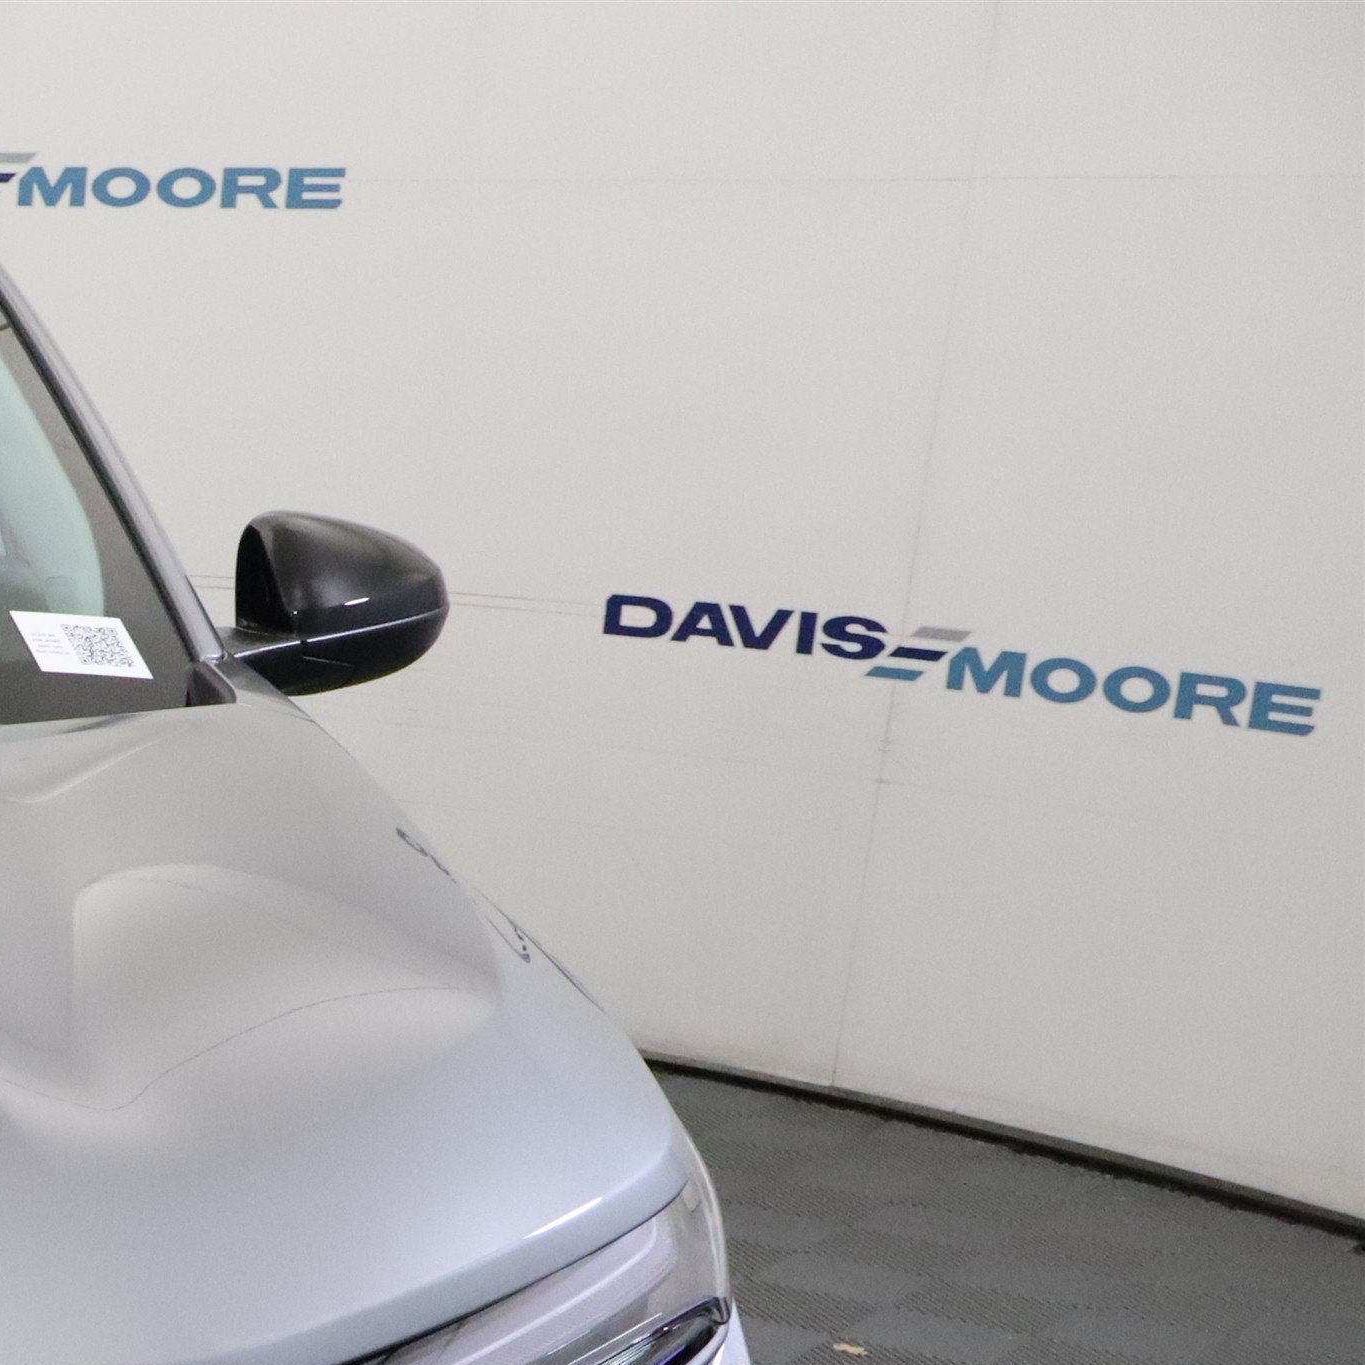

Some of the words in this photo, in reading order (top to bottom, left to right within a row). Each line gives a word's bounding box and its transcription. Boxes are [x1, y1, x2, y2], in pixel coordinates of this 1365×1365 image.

[17, 165, 346, 210] MOORE
[602, 593, 889, 661] DAVIS
[945, 646, 1322, 736] MOORE
